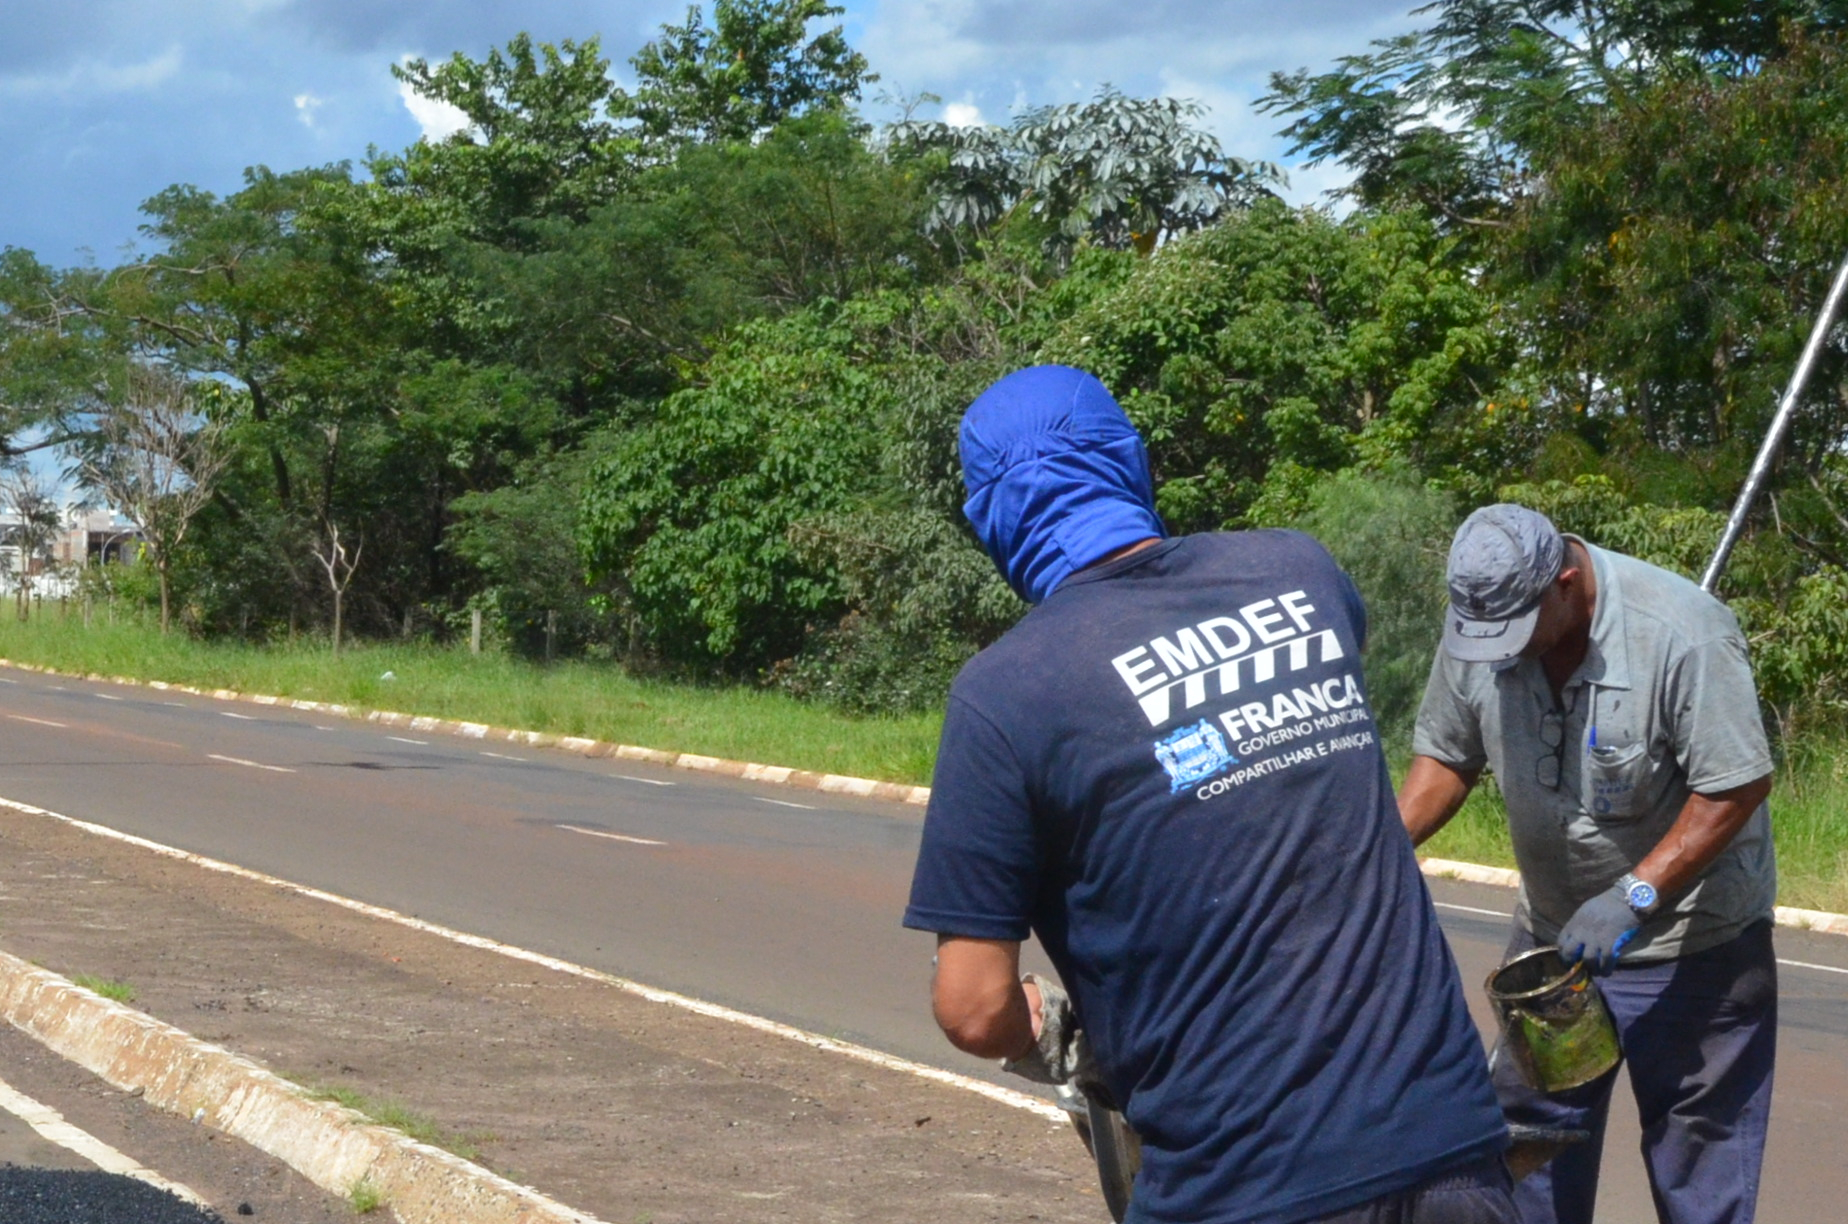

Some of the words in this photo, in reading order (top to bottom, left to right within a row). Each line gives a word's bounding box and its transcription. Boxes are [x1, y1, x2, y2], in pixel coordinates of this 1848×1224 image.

[1111, 590, 1316, 696] EMDEF
[1219, 674, 1364, 742] FRANCA
[1238, 720, 1314, 756] GOVERNO
[1314, 707, 1370, 732] MUNICIPAL
[1196, 747, 1317, 801] COMPARTILHAR
[1316, 742, 1328, 757] E
[1330, 731, 1374, 752] AVANÇAR
